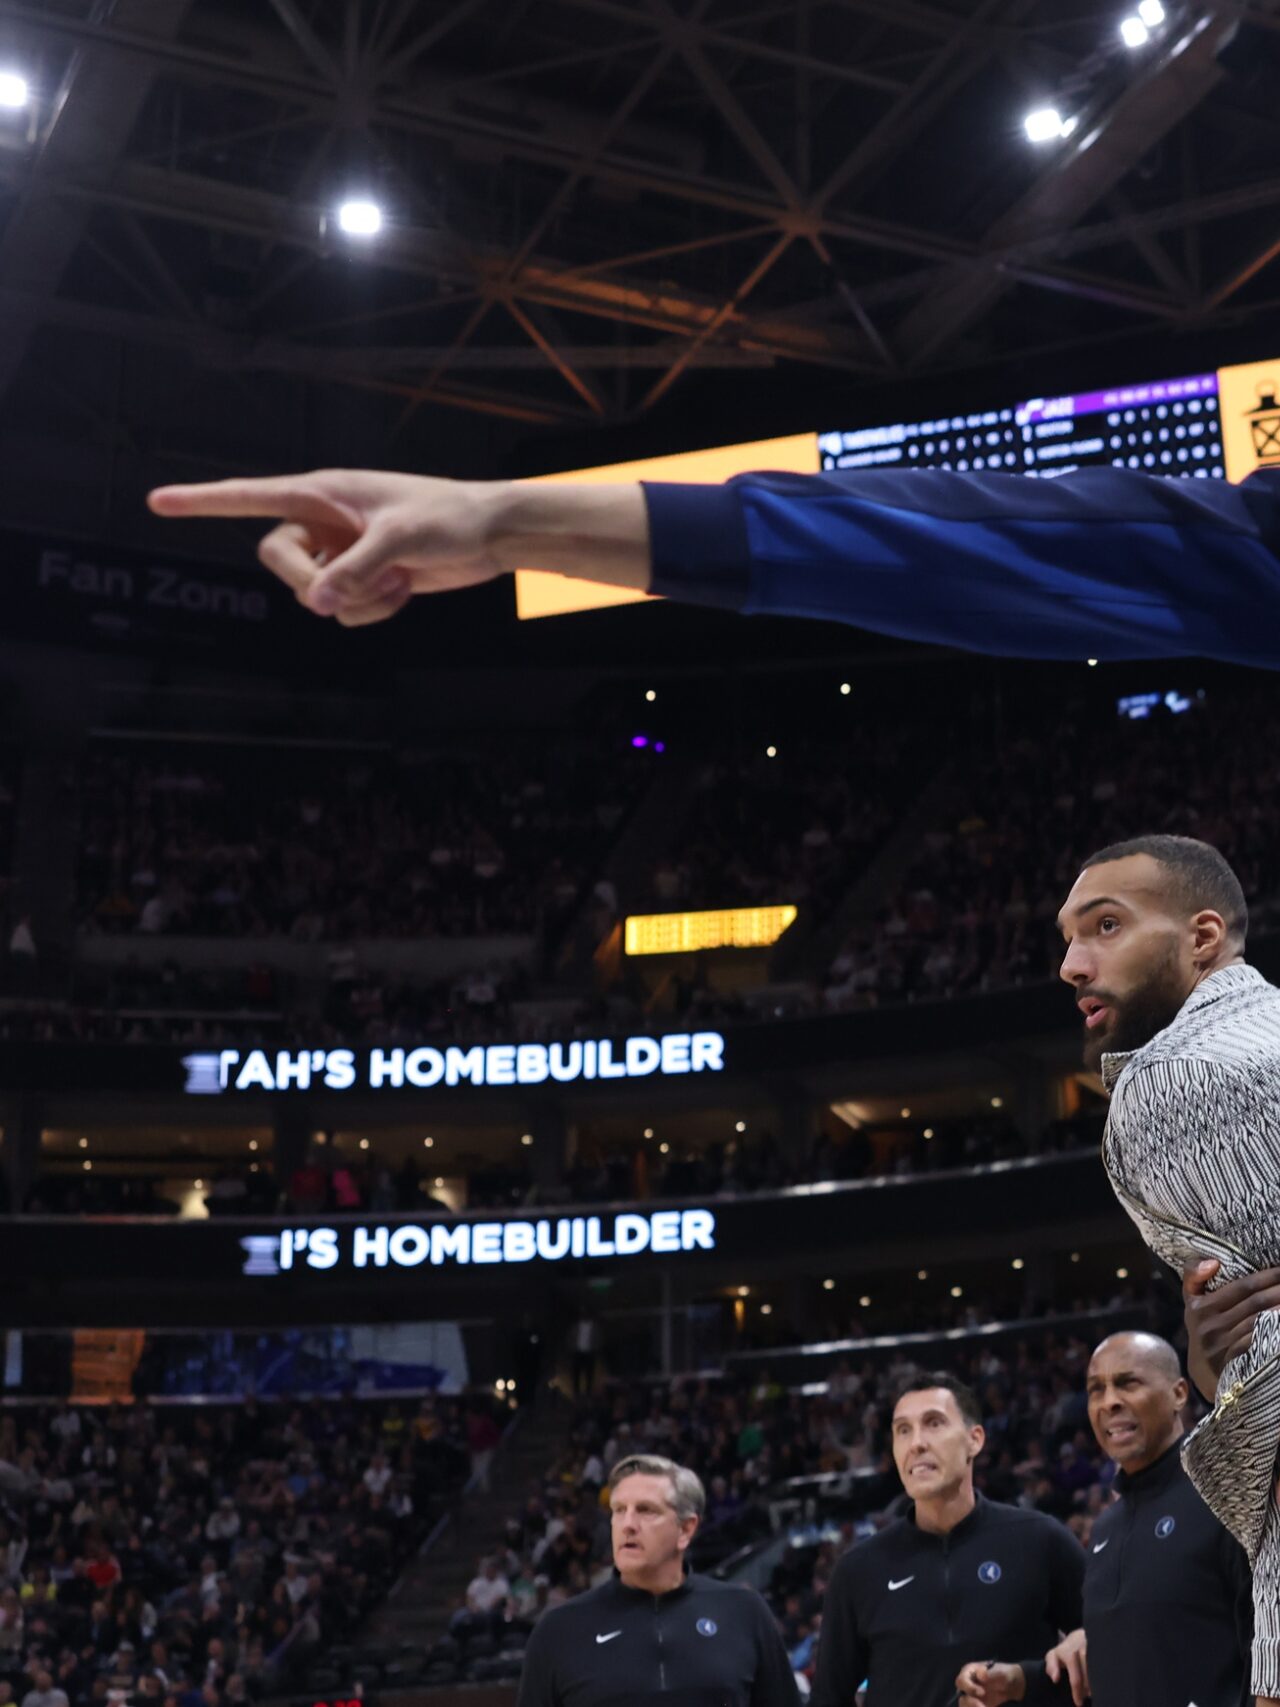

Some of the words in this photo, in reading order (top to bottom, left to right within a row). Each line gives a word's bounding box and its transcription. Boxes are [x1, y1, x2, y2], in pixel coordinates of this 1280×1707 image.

[38, 550, 133, 599] Fan
[148, 567, 268, 621] Zone
[369, 1032, 725, 1088] HOMEBUILDER
[353, 1208, 716, 1268] HOMEBUILDER
